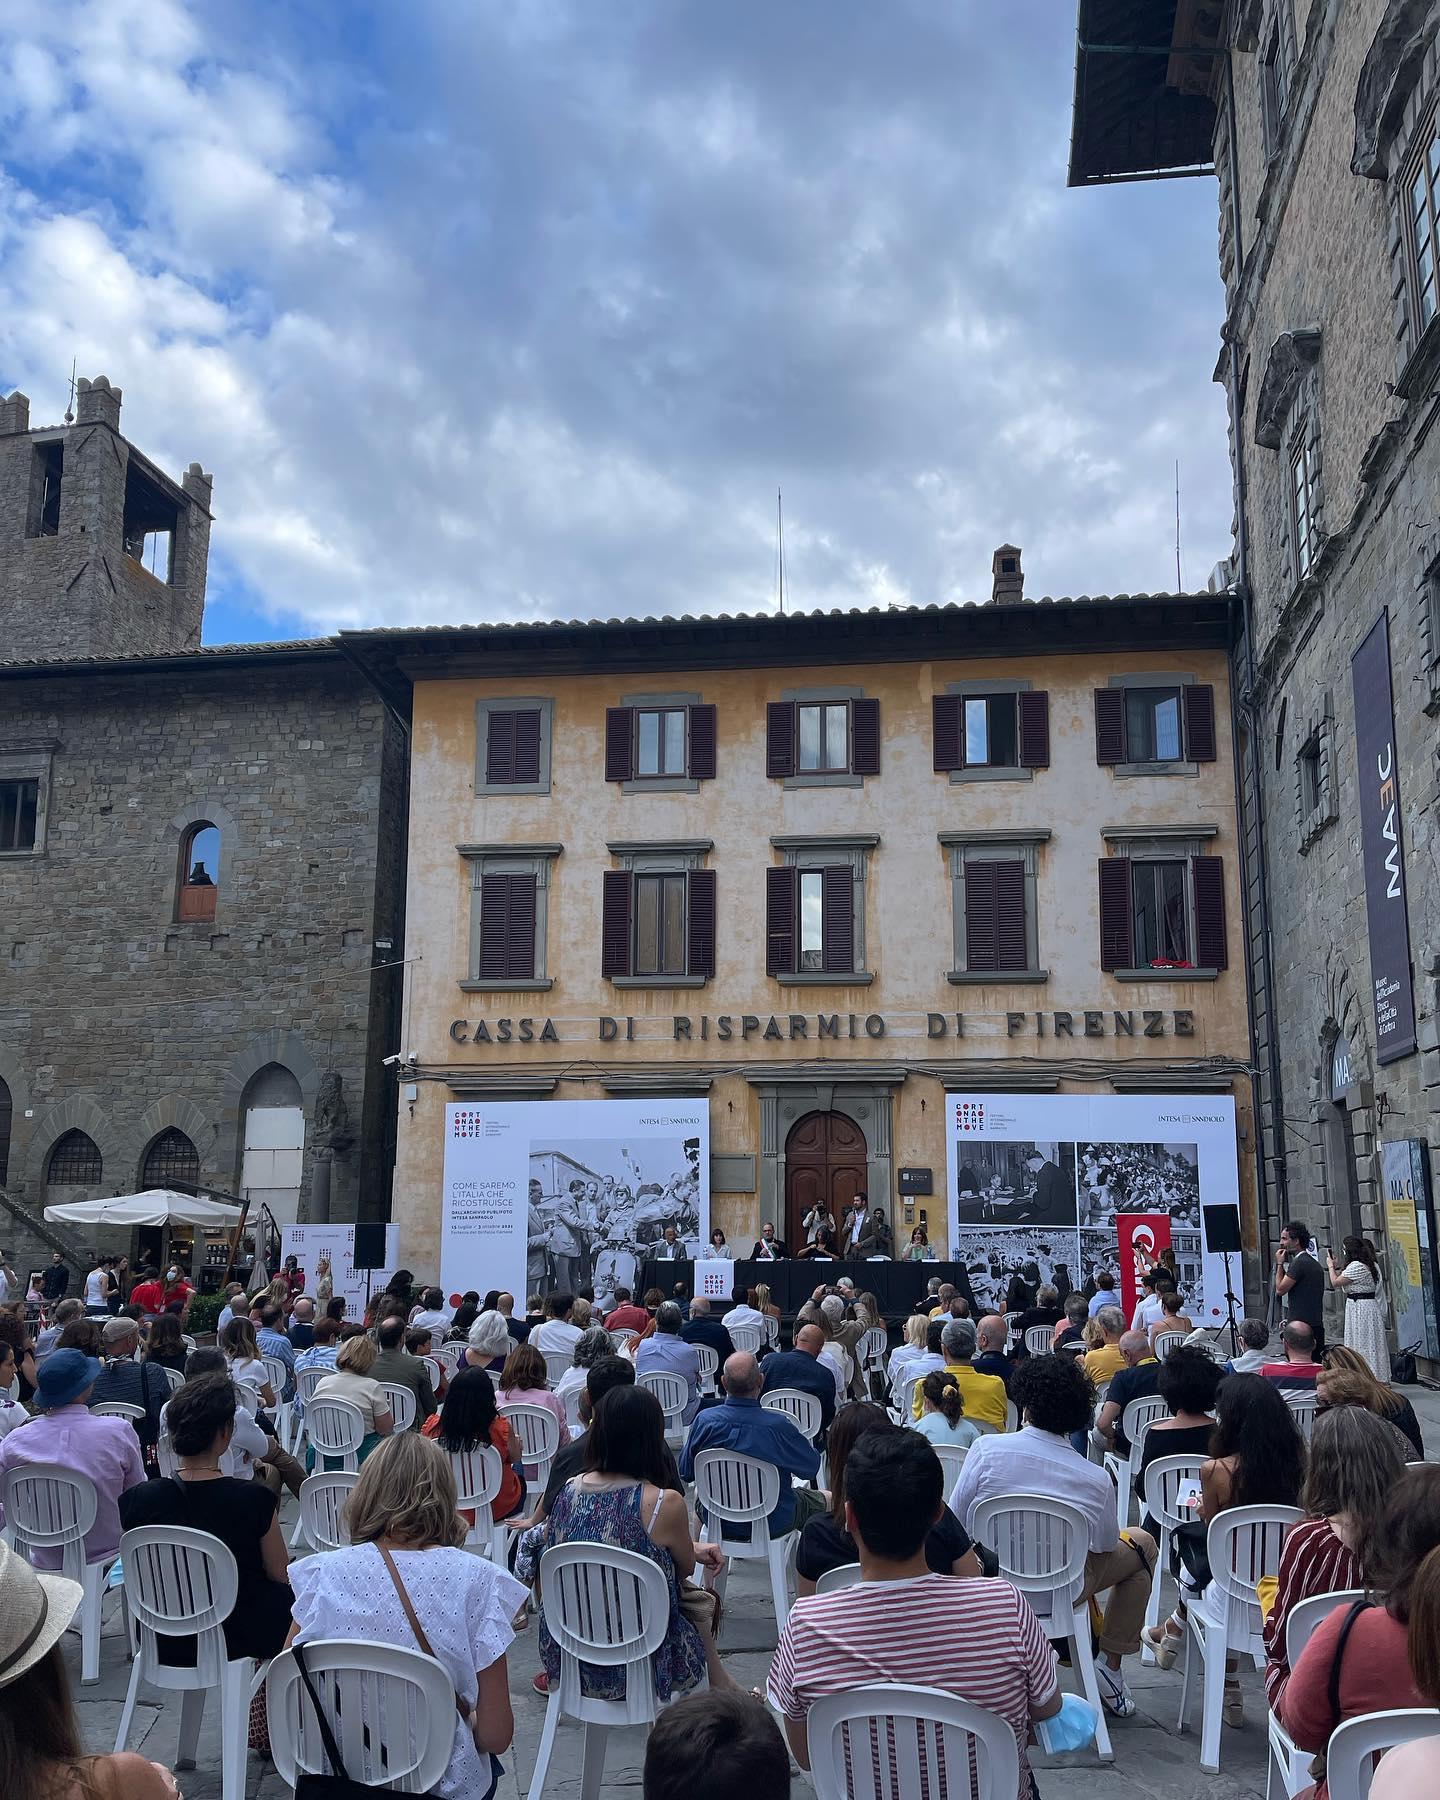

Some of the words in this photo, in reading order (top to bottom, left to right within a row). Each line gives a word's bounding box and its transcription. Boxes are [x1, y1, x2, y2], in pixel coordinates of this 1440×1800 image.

[1377, 742, 1401, 899] MAEC
[449, 1017, 560, 1043] CASSA
[598, 1016, 635, 1041] DI
[673, 1013, 886, 1041] RISPARMIO
[927, 1012, 964, 1039] DI
[1006, 1010, 1195, 1038] FIRENZE
[1335, 1053, 1352, 1088] MA
[452, 1182, 478, 1190] COME
[480, 1181, 516, 1190] SAREMO
[452, 1190, 485, 1199] L'ITALIA
[486, 1190, 505, 1198] CHE
[452, 1198, 513, 1207] RICOSTRUISCE
